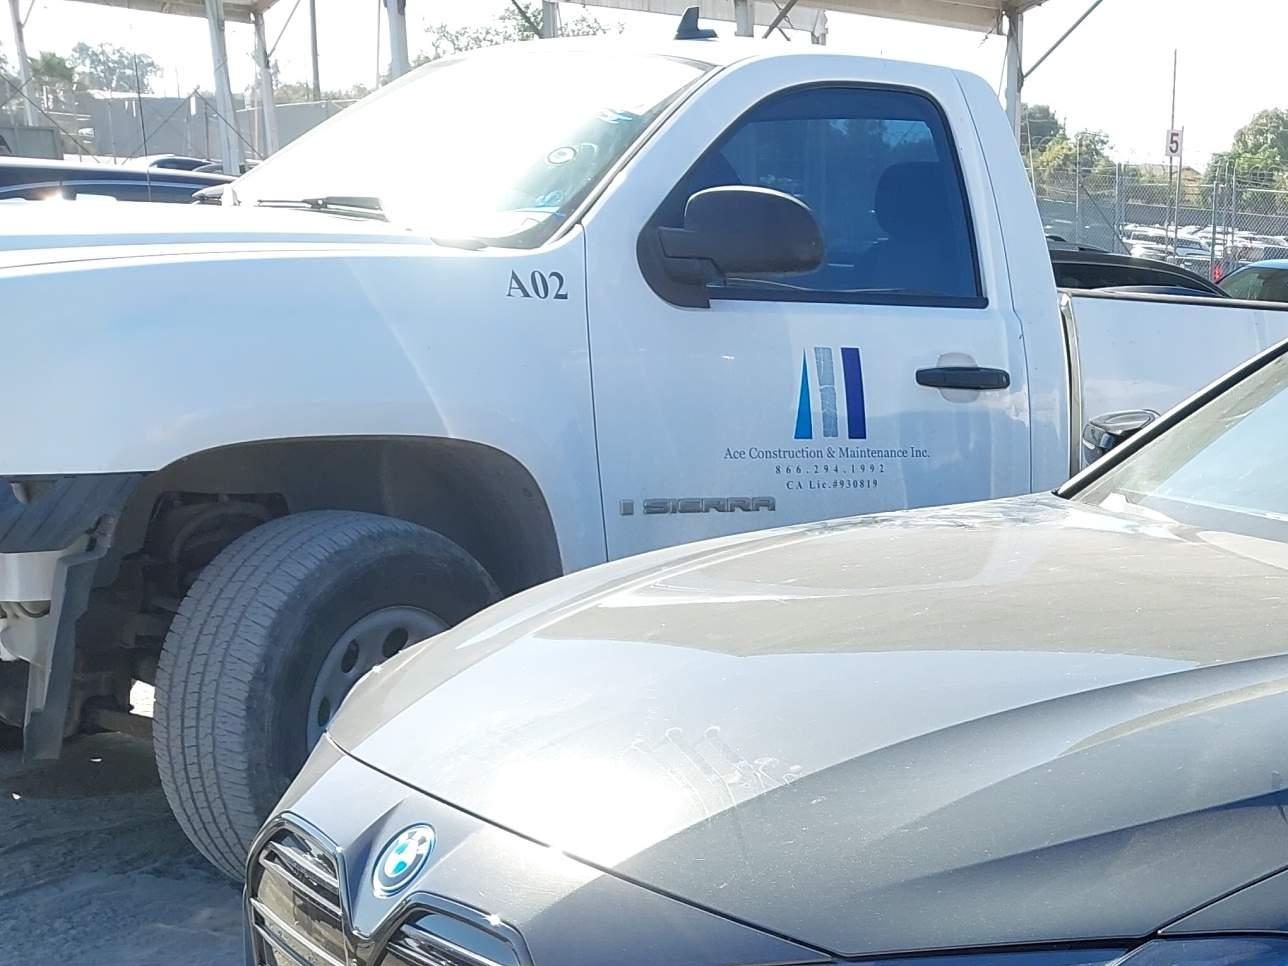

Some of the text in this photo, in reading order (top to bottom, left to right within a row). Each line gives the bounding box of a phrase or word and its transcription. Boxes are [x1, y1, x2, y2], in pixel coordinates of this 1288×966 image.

[1169, 132, 1180, 154] 5
[506, 269, 568, 300] A02
[724, 446, 931, 460] Ace Construction & Maintenance Inc.
[775, 464, 885, 475] 866.294.1992
[786, 480, 803, 490] CA
[643, 496, 776, 515] SIERRA
